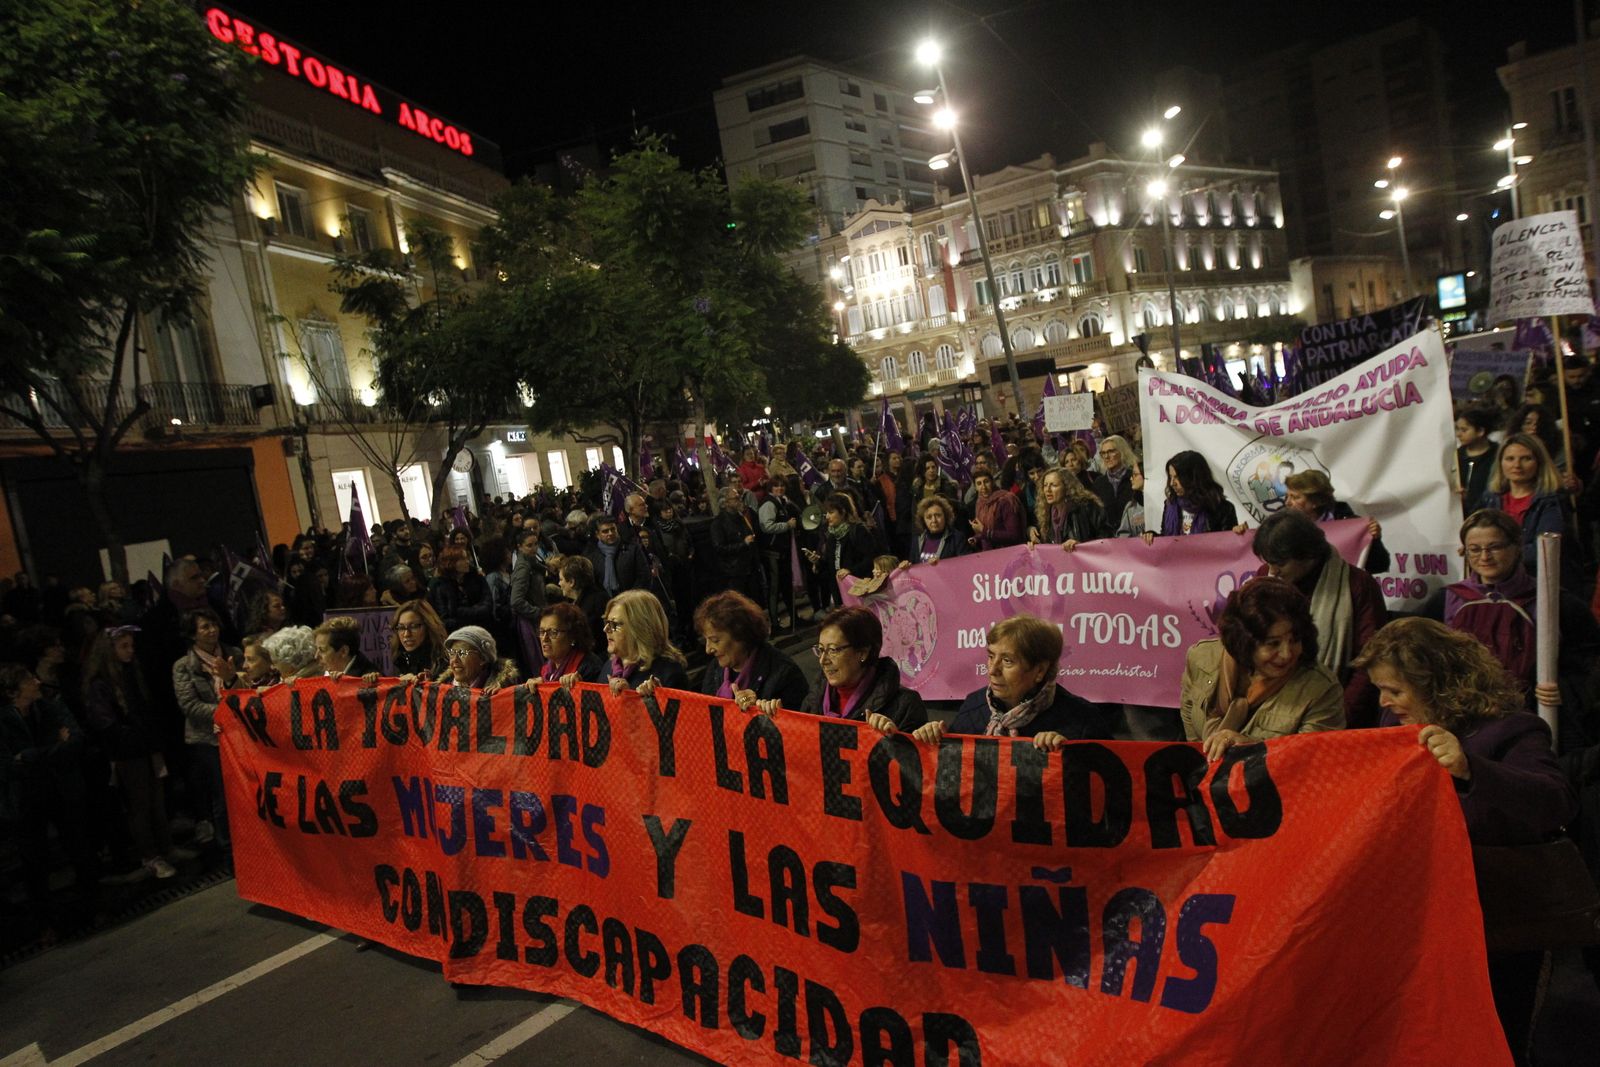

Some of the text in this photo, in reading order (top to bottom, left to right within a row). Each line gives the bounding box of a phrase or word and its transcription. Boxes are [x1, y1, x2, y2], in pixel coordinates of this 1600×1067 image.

[207, 8, 473, 156] GESTORIA ARCOS
[1301, 315, 1377, 345] CONTRA
[1353, 346, 1428, 392] AYUDA
[1254, 415, 1285, 436] DE
[1288, 379, 1424, 433] ANDALUCÍA
[1414, 553, 1448, 575] UN
[972, 571, 1139, 603] Si tocan a una,
[1070, 612, 1183, 651] TODAS
[1088, 662, 1159, 678] machistas!
[291, 688, 340, 750] LA
[357, 684, 612, 769] IGUALDAD
[641, 694, 681, 778] Y
[708, 704, 790, 806] LA
[818, 721, 1284, 849] EQUIDAD
[298, 774, 378, 838] LAS
[641, 814, 693, 899] Y
[728, 829, 861, 954] LAS
[901, 866, 1236, 1014] NIÑAS
